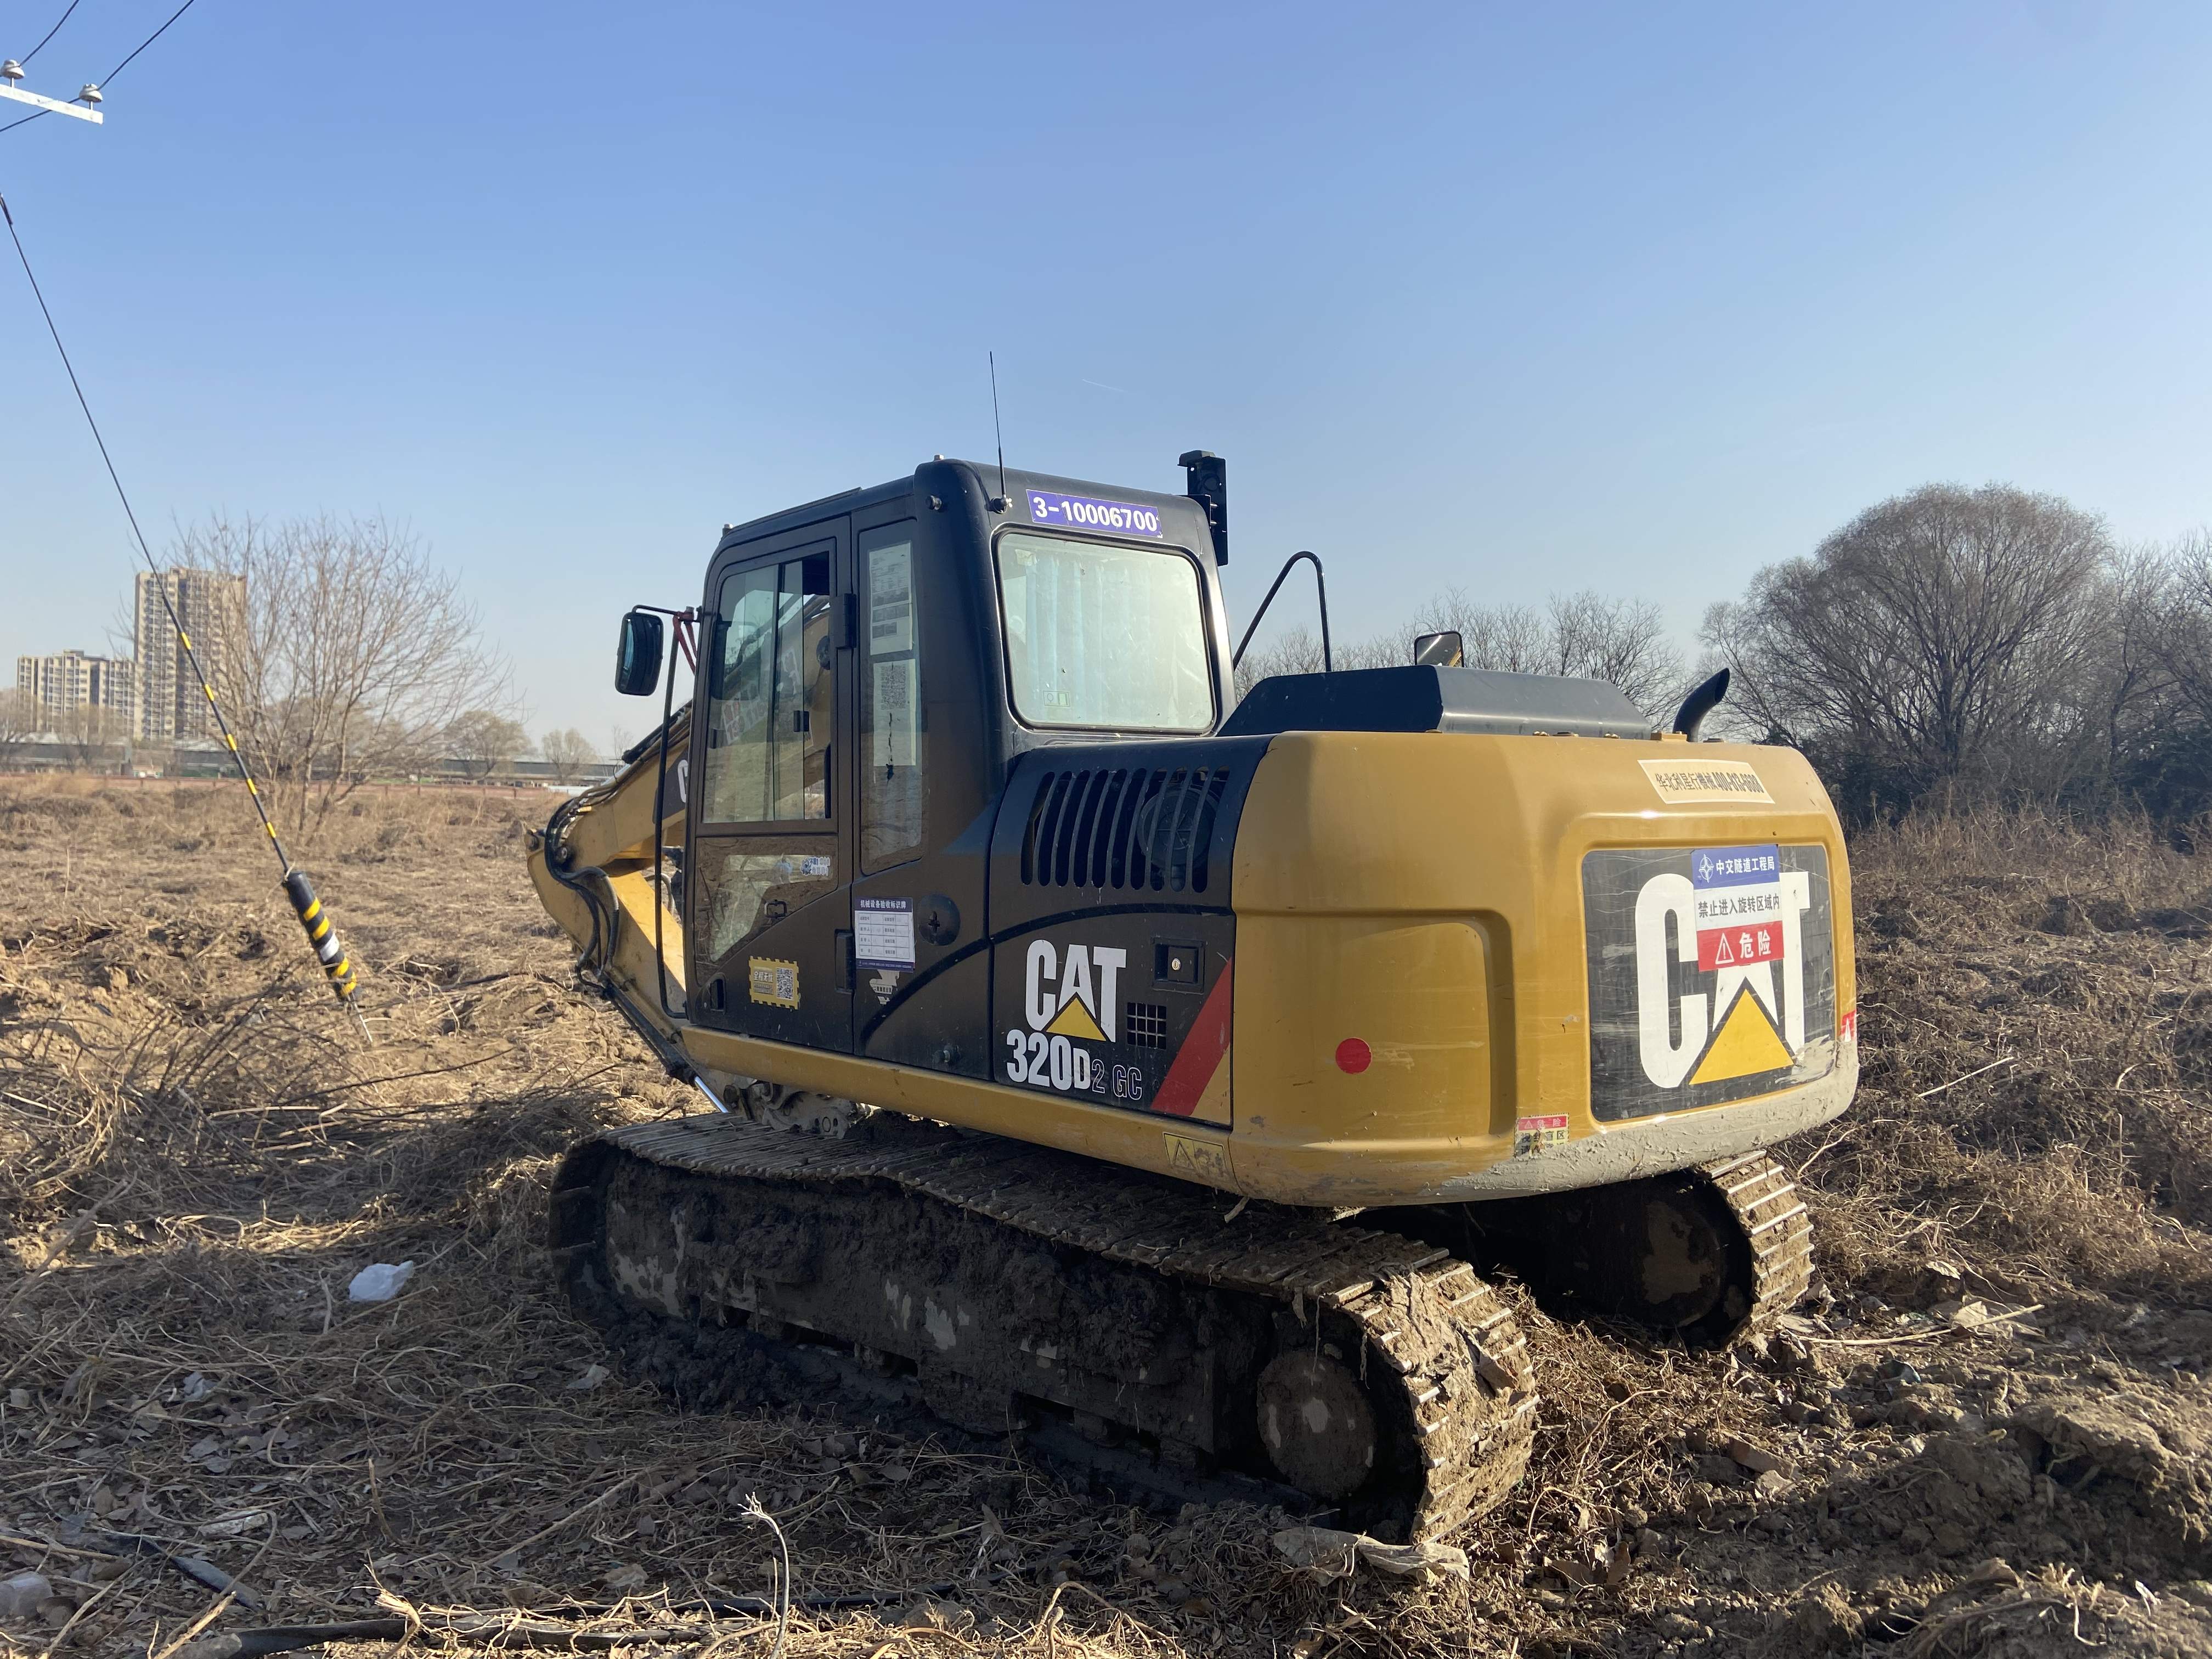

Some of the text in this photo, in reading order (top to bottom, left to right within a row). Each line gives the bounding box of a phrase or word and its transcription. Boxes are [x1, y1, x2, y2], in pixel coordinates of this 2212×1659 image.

[1034, 496, 1157, 532] 3-10006700
[1716, 856, 1775, 875] 中交隧道工程局
[1699, 893, 1780, 918] 禁止进入旋转区域内
[1739, 929, 1771, 959] 危险
[1025, 939, 1127, 1042] CAT
[1113, 1064, 1142, 1101] GC
